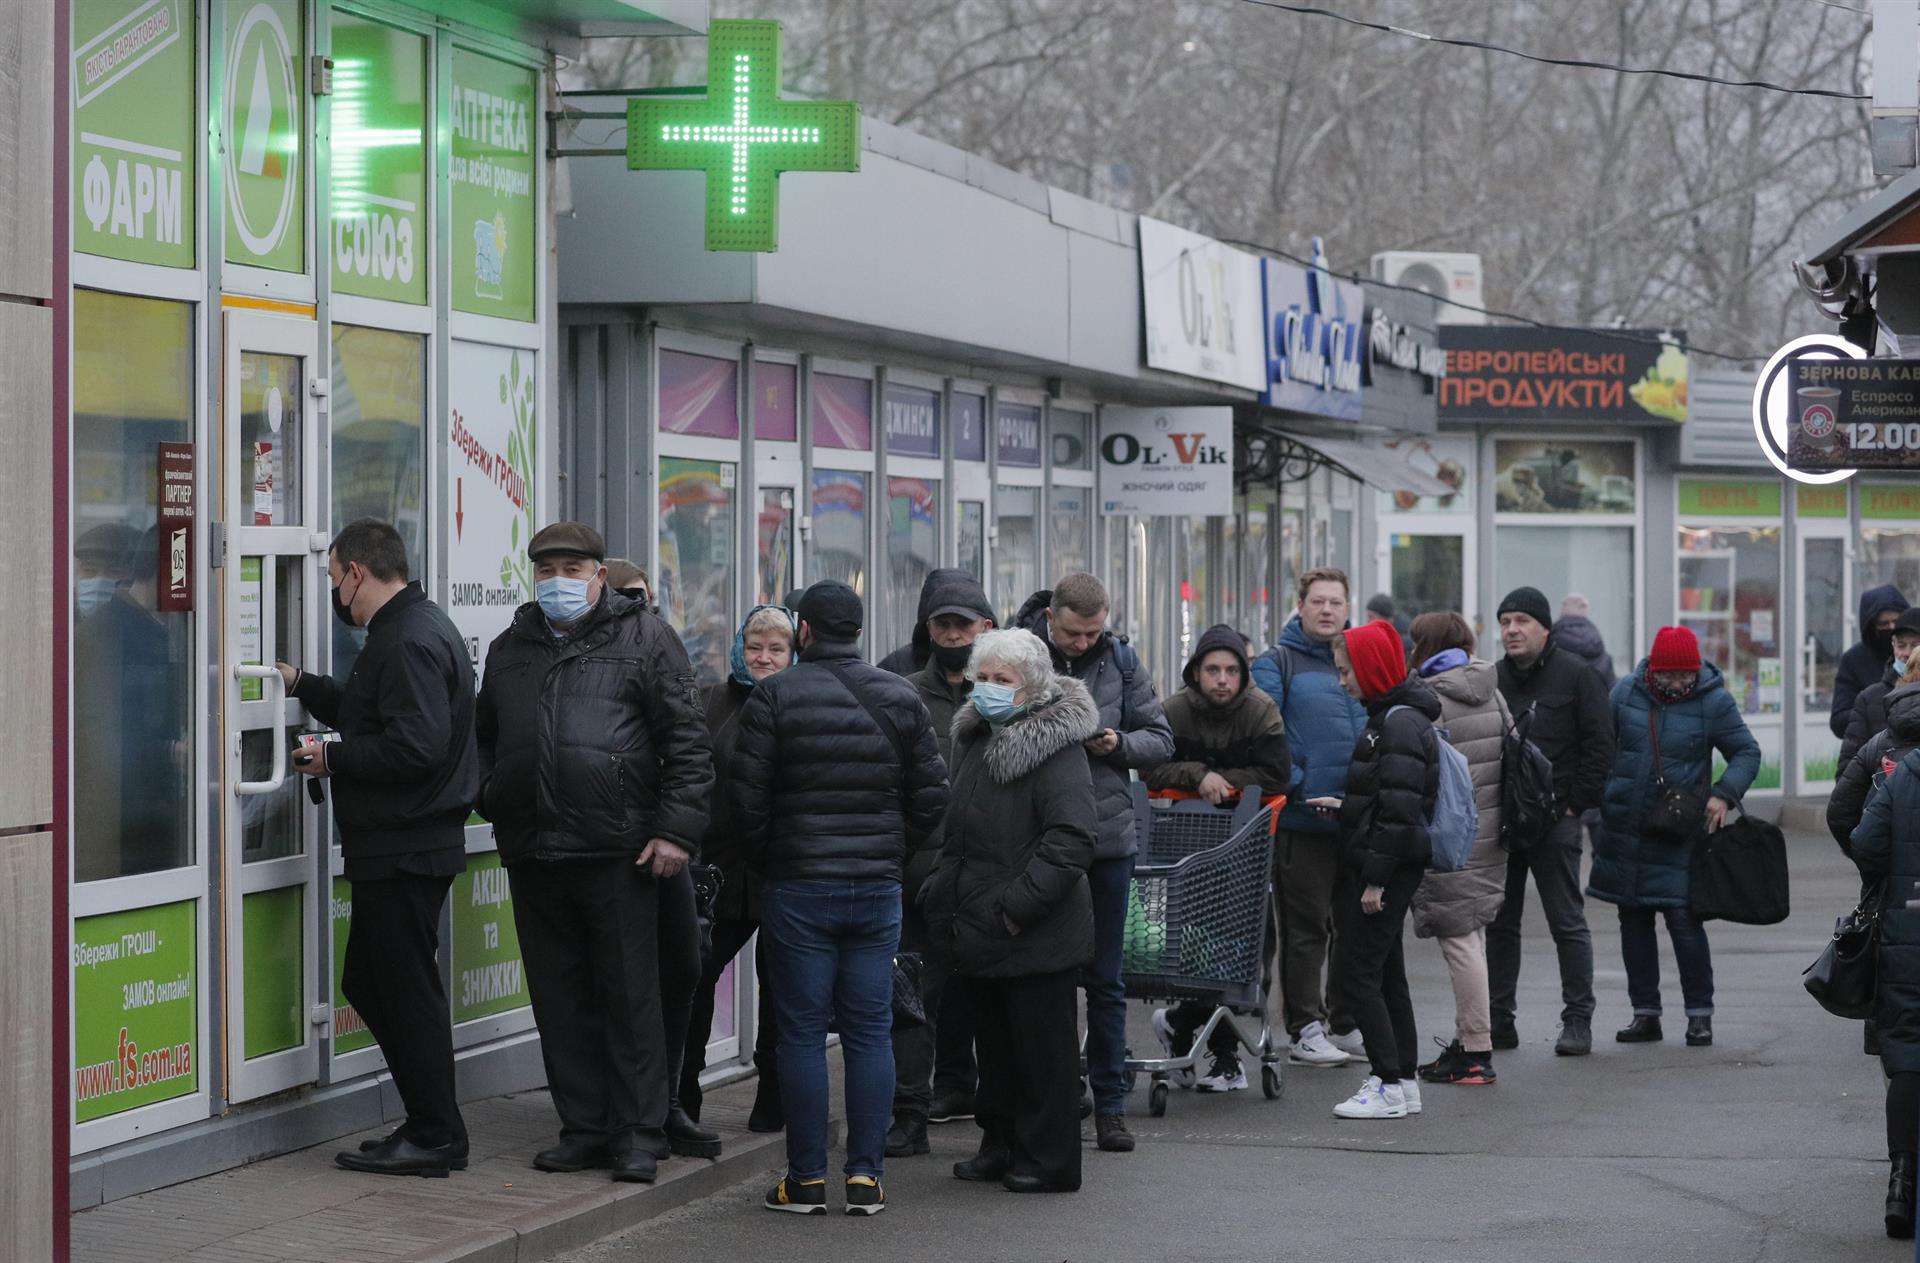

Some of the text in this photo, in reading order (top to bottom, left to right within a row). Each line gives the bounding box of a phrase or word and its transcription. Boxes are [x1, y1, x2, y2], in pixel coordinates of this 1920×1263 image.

[86, 6, 170, 85] ЯКІСТЬ ГАРАНТОВАНО
[450, 84, 529, 154] АПТЕКА
[83, 153, 181, 245] ФАРМ
[336, 211, 413, 284] СОЮЗ
[1799, 366, 1883, 380] ЗЕРНОВА
[1440, 378, 1625, 408] ПРОДУКТИ
[1851, 390, 1914, 404] Еспресо
[1846, 422, 1920, 450] 12.00
[451, 408, 526, 512] Збережи ГРОШІ
[165, 484, 192, 503] ПАРТНЕР
[452, 583, 520, 606] ЗАМОВ онлайн!
[74, 942, 119, 970] Збережи
[121, 930, 155, 958] ГРОШІ
[483, 922, 498, 950] та
[122, 972, 190, 1010] ЗАМОВ онлайн!
[462, 960, 521, 1007] ЗНИЖКИ
[76, 1027, 192, 1101] www.fs.com.ua
